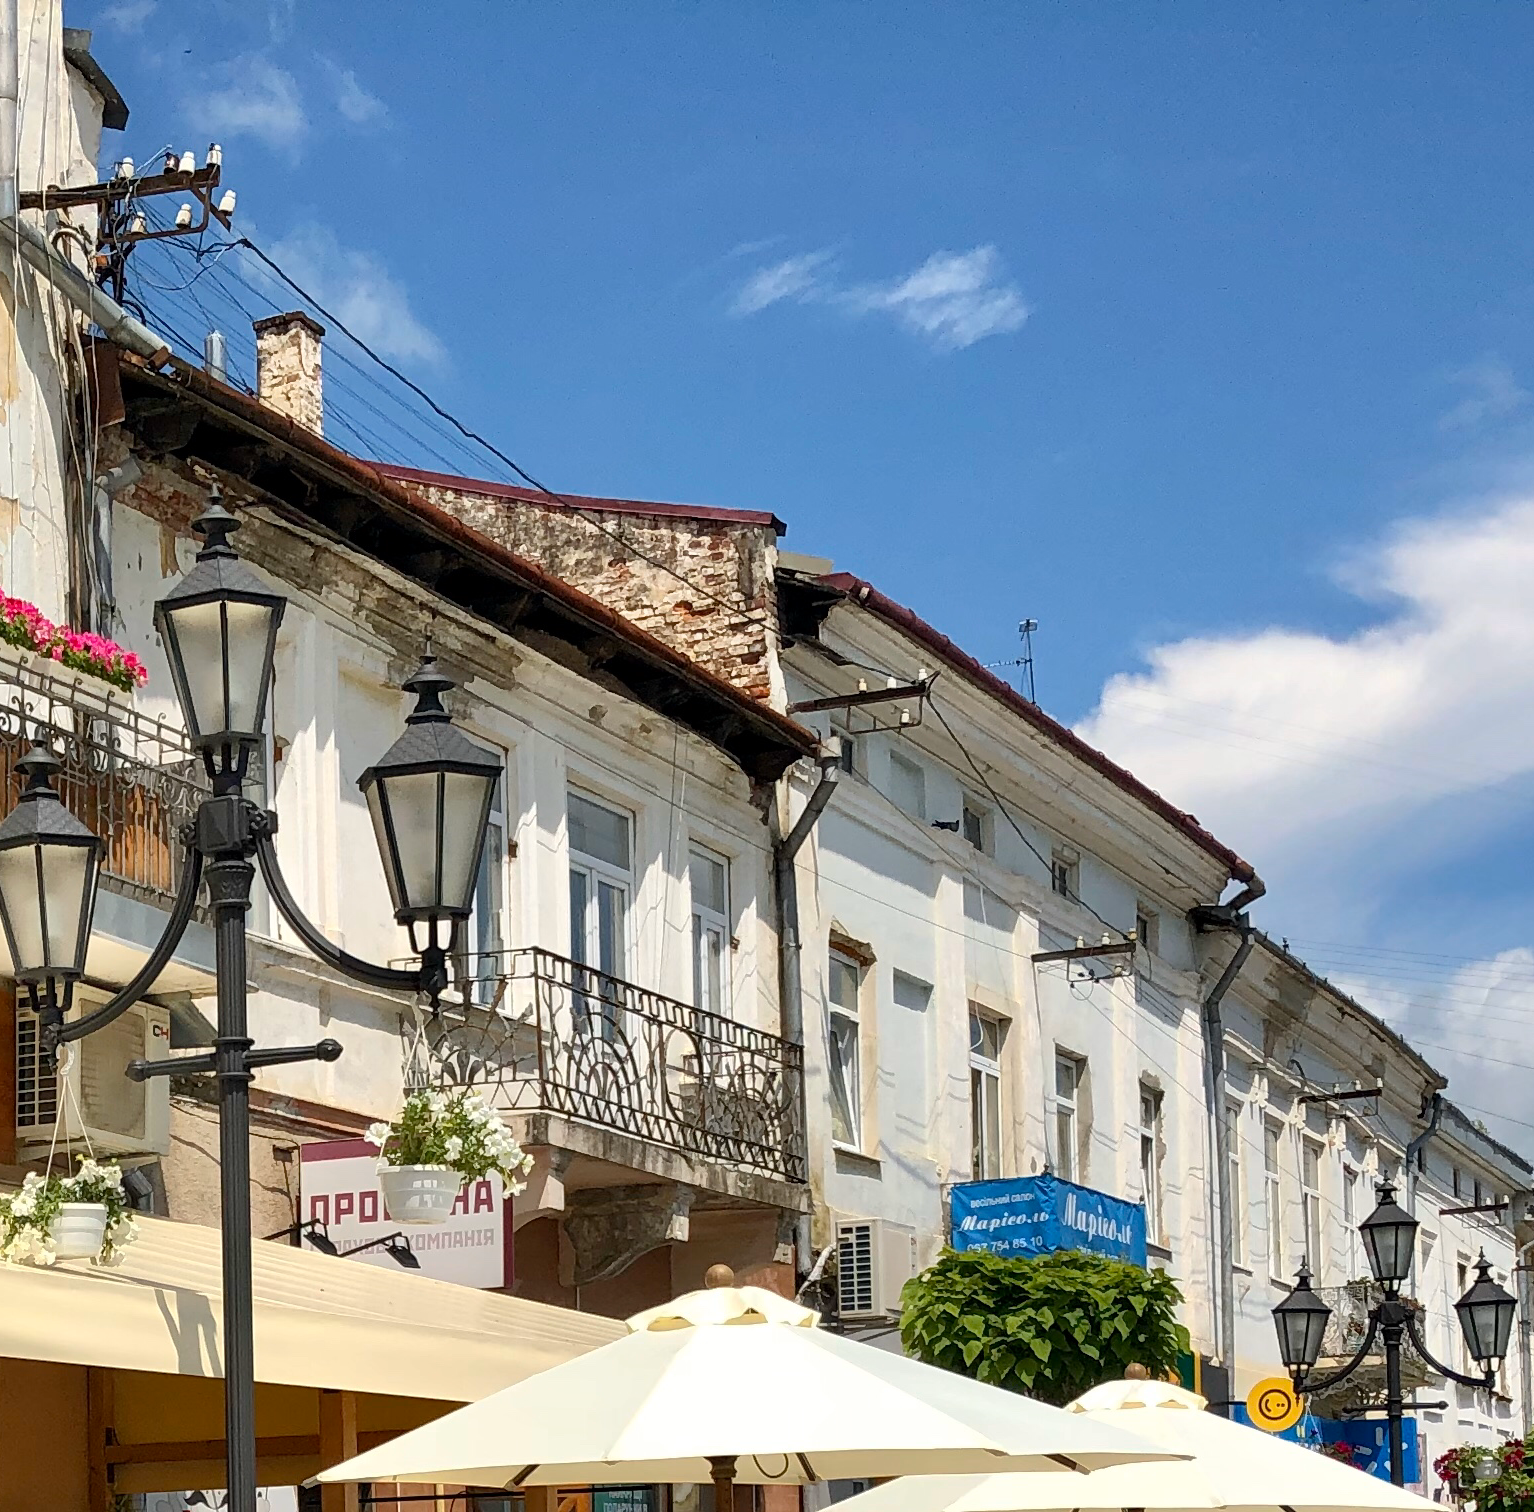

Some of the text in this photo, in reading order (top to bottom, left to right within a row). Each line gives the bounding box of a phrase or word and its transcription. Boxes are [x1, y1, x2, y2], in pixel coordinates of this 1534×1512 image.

[310, 1180, 495, 1226] ПРОНА
[991, 1240, 1010, 1252] 754
[1012, 1237, 1027, 1249] 85
[1030, 1235, 1043, 1248] 10
